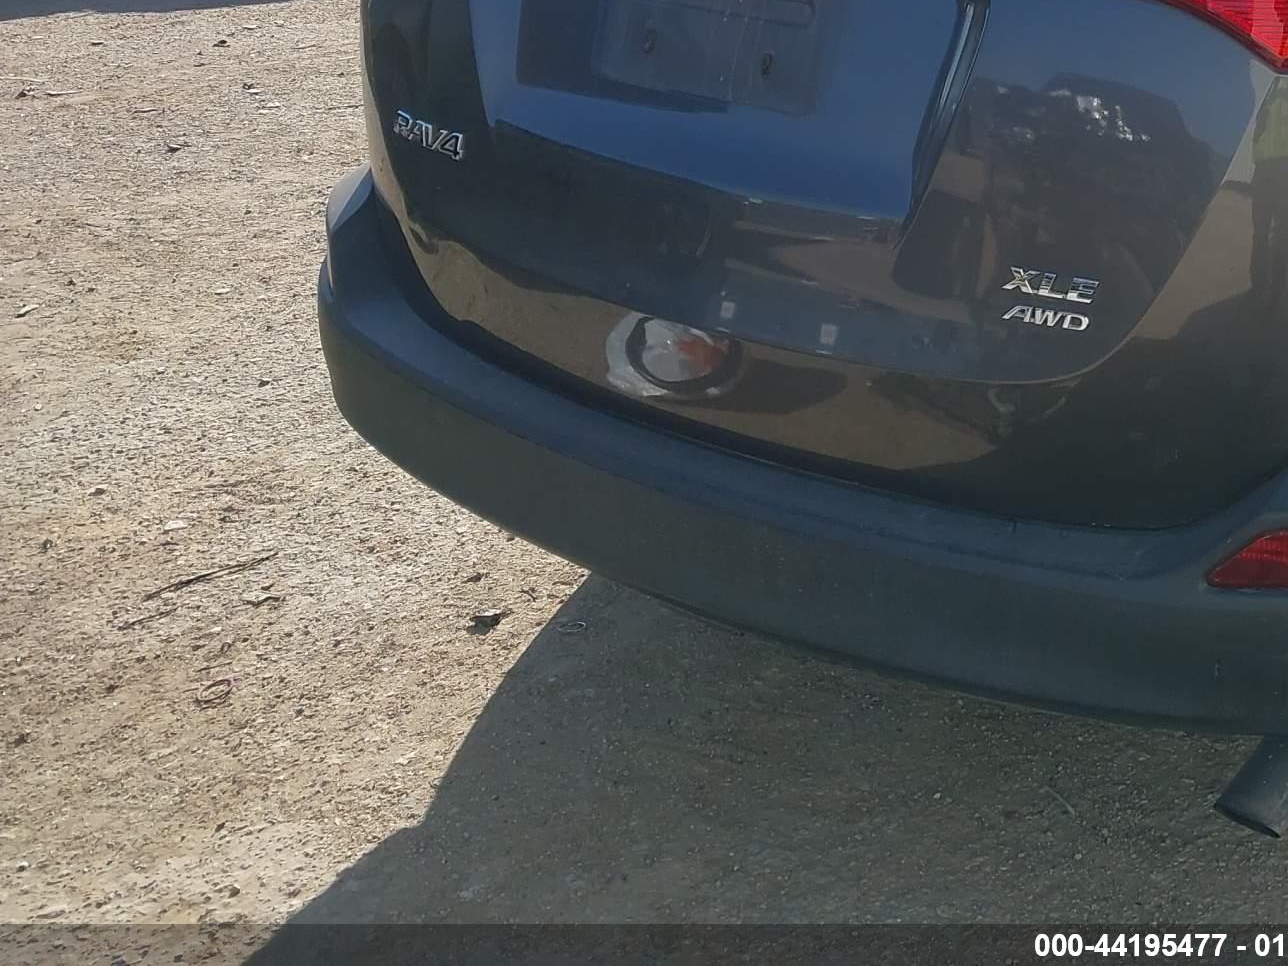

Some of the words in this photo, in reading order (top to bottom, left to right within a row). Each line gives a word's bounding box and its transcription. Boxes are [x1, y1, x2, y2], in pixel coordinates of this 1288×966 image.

[393, 110, 464, 161] RAV4
[1001, 266, 1100, 304] XLE
[1001, 305, 1090, 331] AWD
